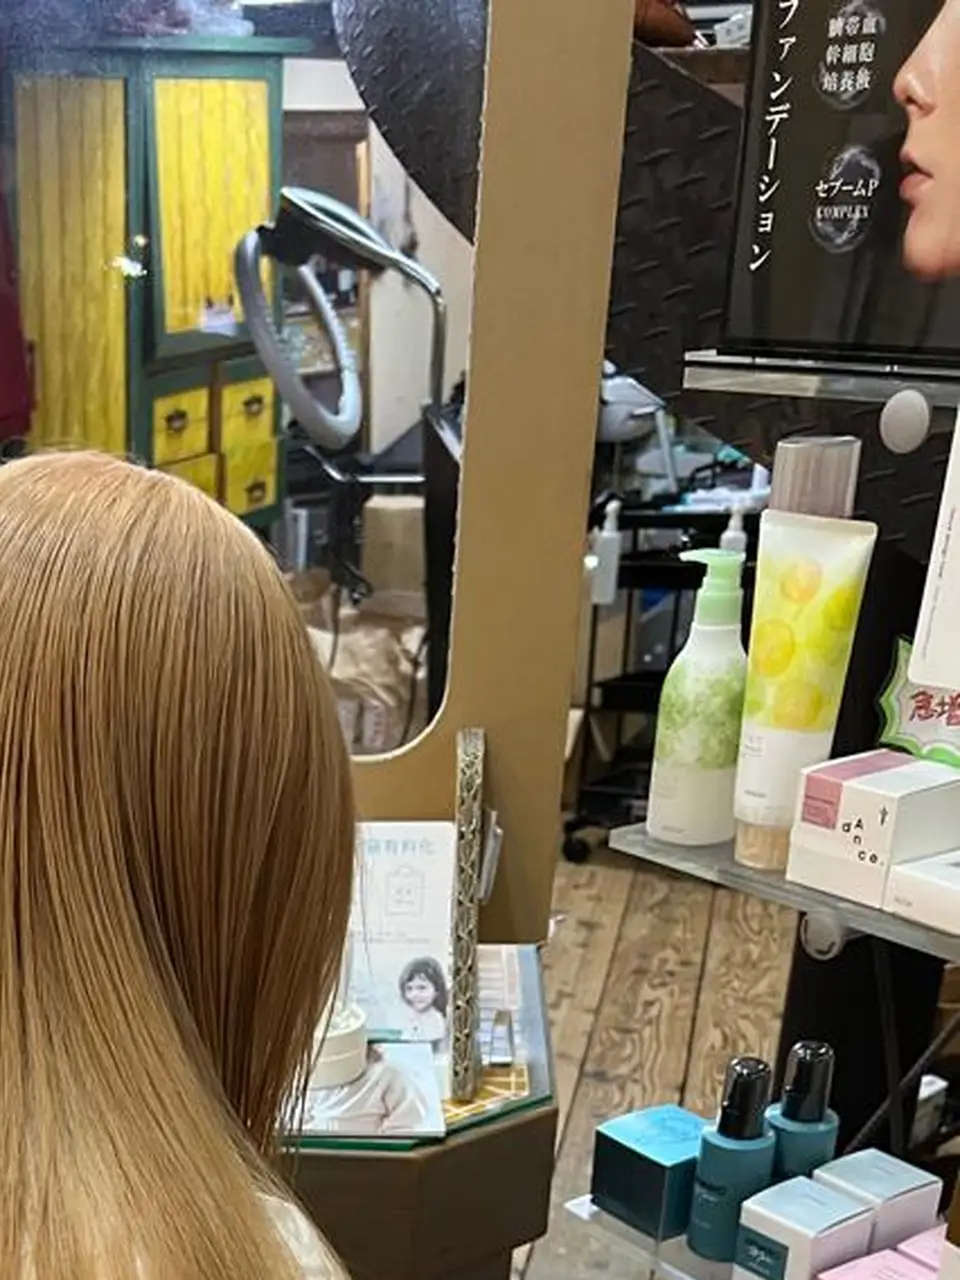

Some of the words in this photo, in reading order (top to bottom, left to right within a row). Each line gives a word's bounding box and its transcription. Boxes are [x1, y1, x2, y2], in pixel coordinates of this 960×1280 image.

[748, 0, 799, 272] ファンデーション
